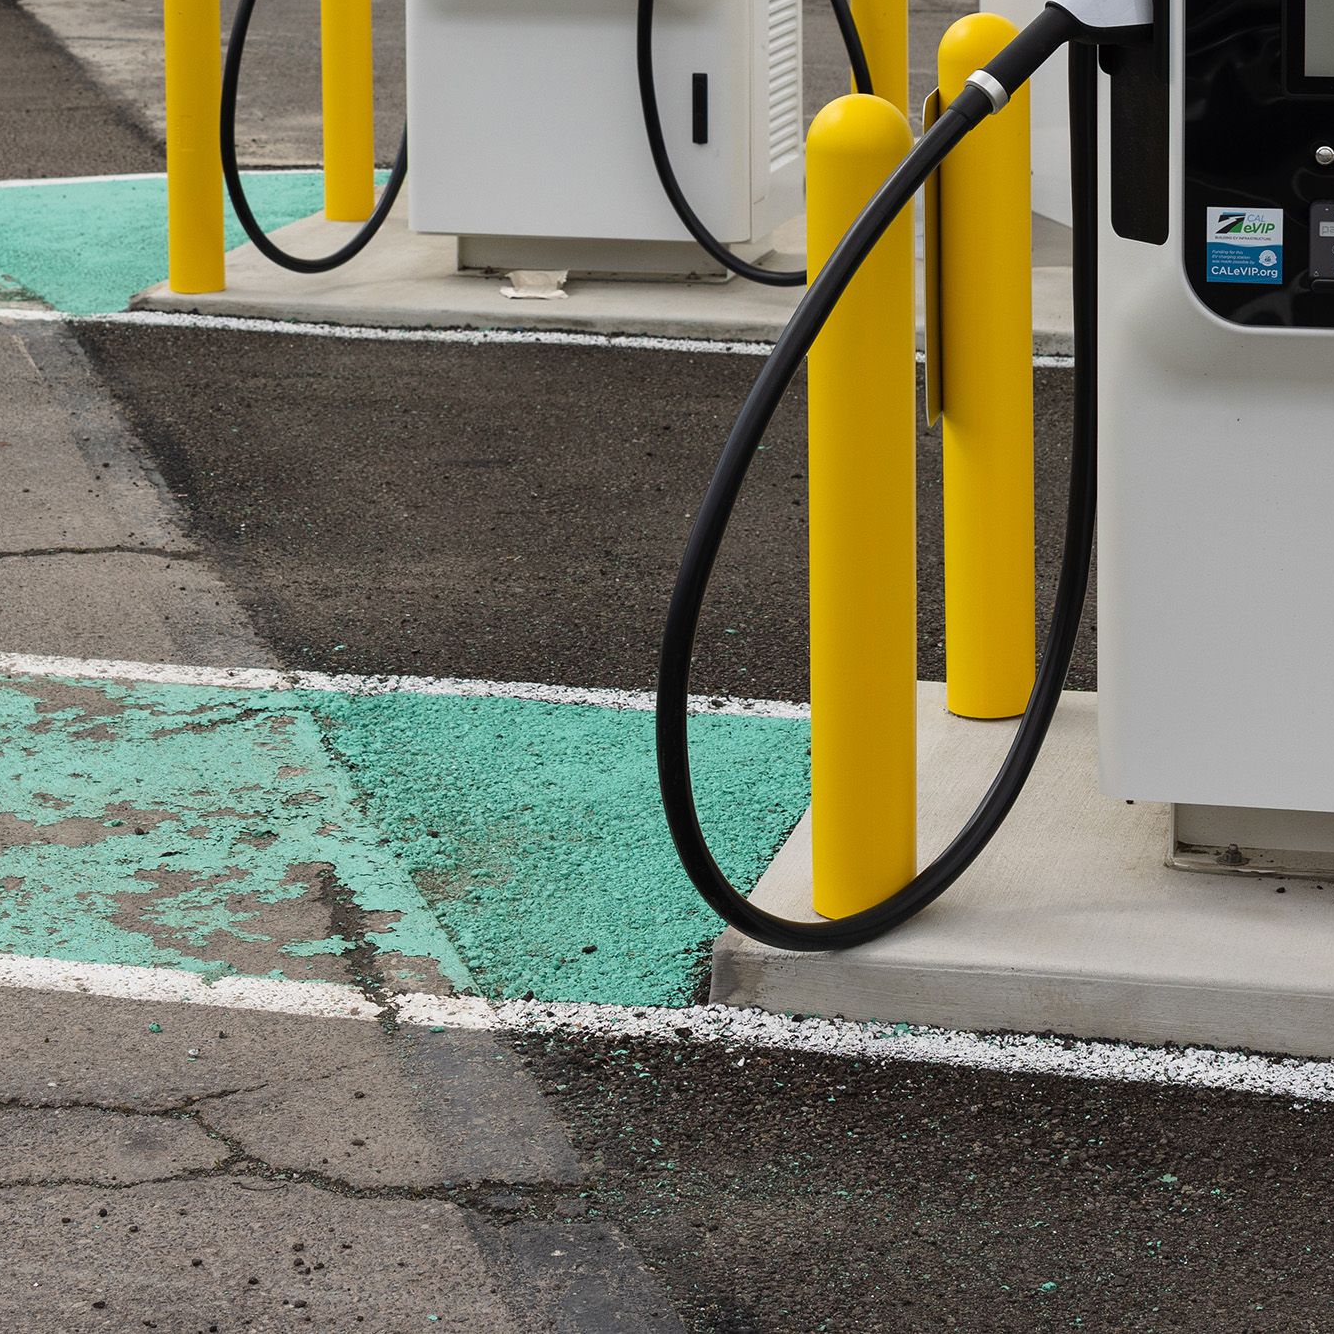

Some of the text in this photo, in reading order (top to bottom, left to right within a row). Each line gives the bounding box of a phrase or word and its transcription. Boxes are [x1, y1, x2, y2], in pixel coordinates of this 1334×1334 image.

[1247, 214, 1266, 223] CAL
[1243, 222, 1276, 234] eVIP
[1211, 266, 1278, 278] CALeVIP.org
